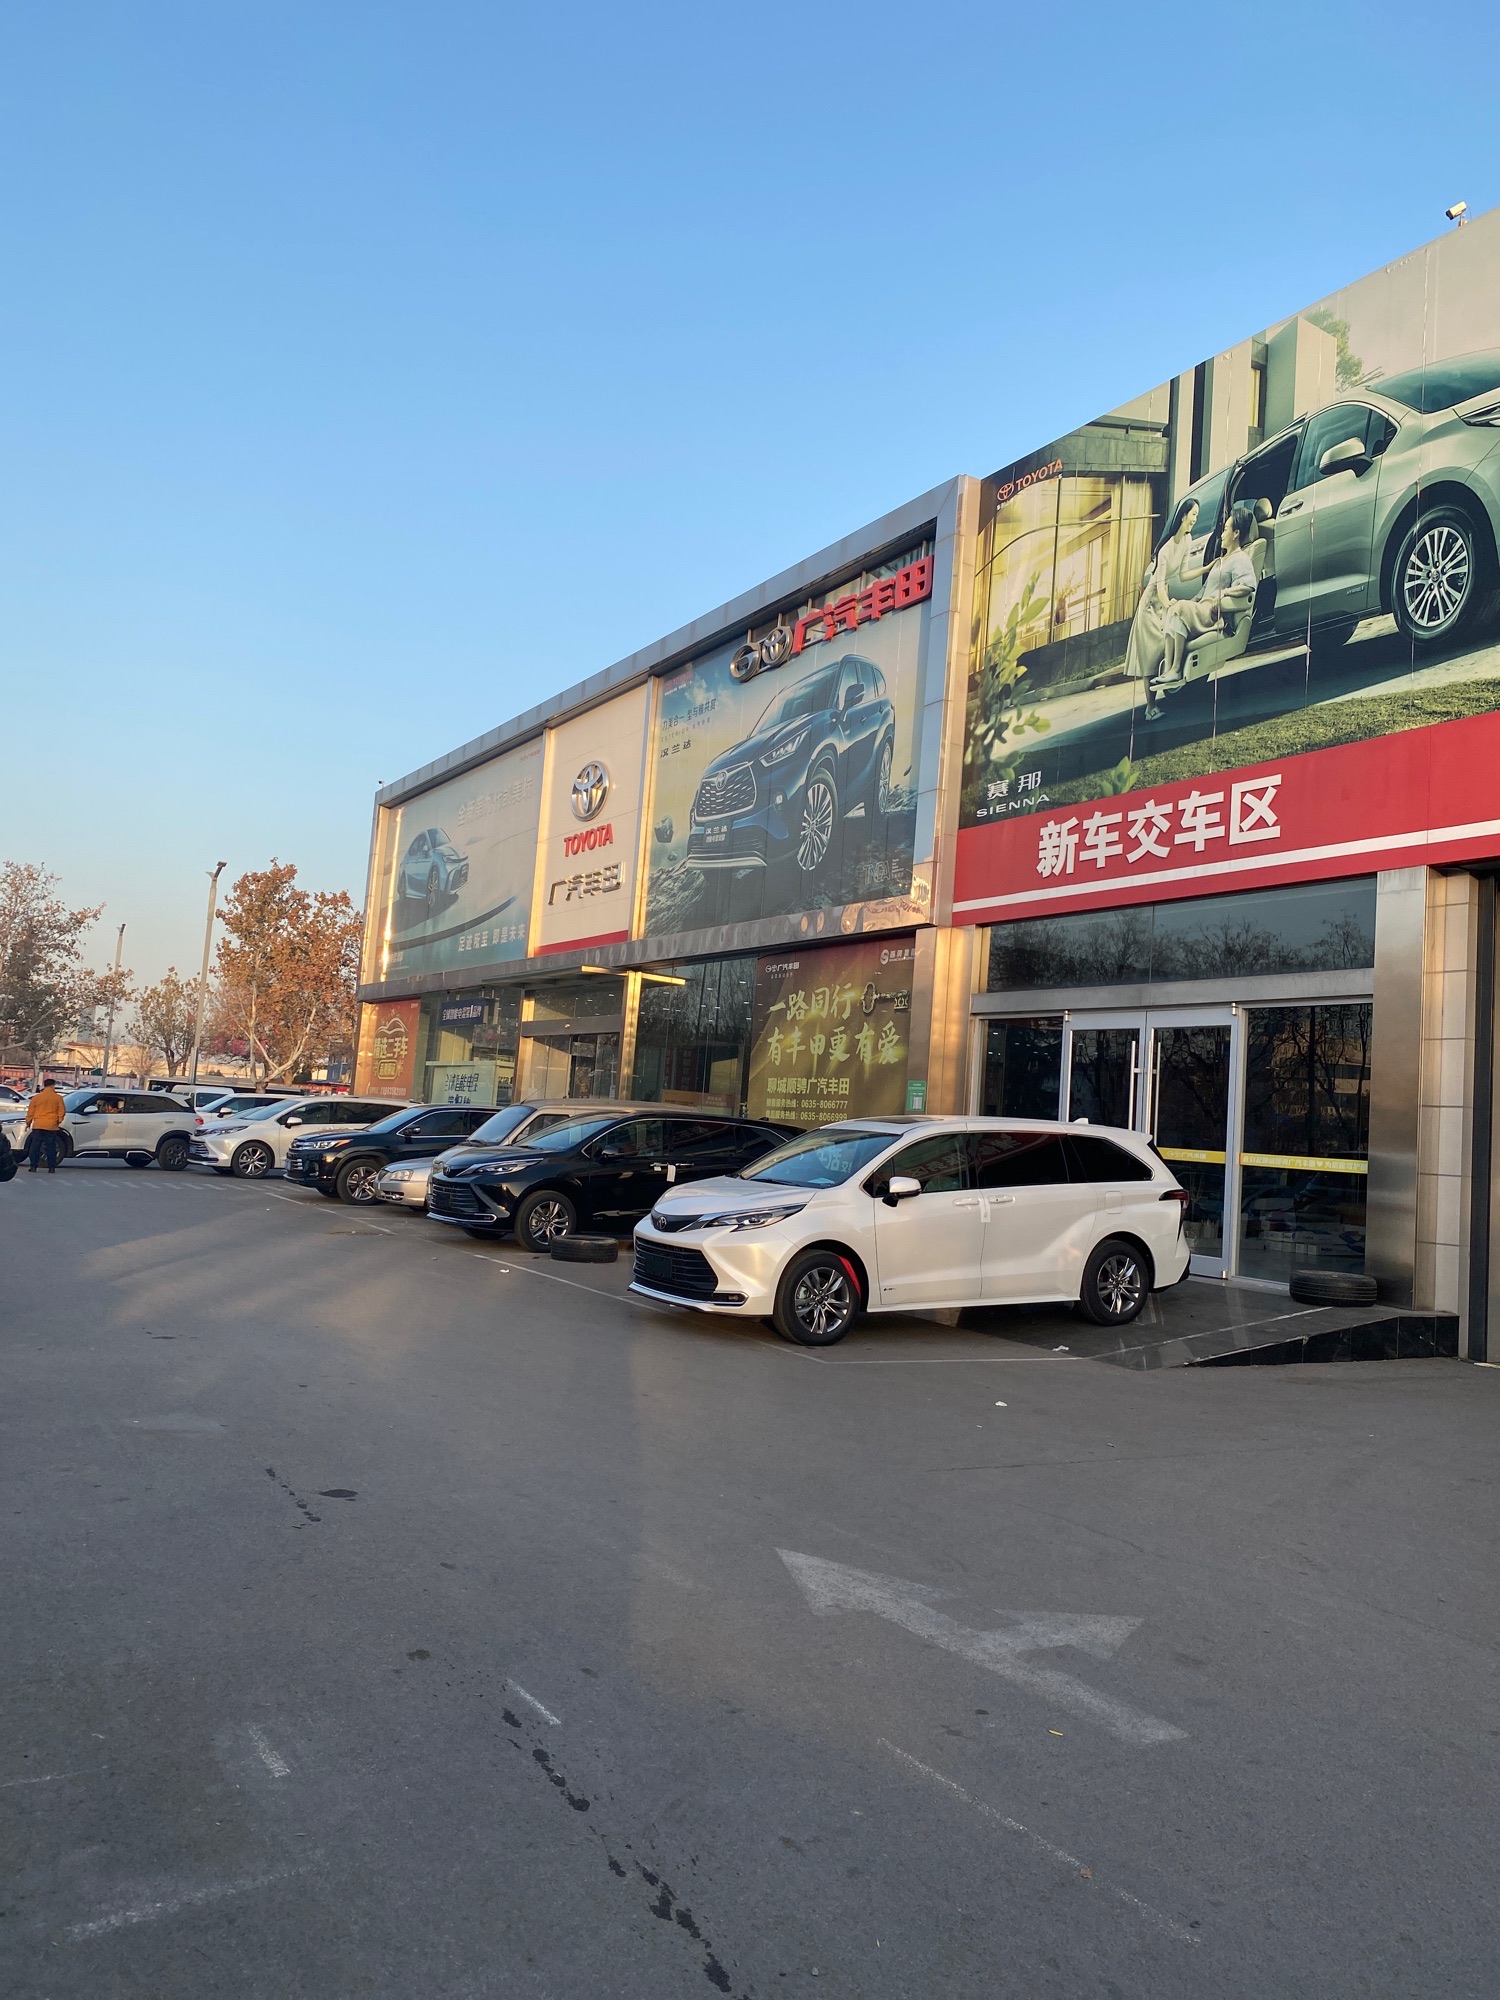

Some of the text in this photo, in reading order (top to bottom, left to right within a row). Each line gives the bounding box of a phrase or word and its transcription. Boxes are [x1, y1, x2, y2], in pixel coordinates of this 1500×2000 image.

[1016, 458, 1063, 491] TOYOTA
[790, 555, 934, 654] 广汽丰田
[987, 771, 1042, 800] 赛那
[976, 794, 1050, 817] SIENNA
[564, 823, 614, 857] TOYOTA
[1037, 774, 1283, 878] 新车交车区
[548, 861, 625, 906] 广汽丰田
[863, 861, 890, 884] TNGA
[458, 924, 526, 952] 足迹所至 即是未来
[777, 962, 800, 971] 广汽丰田
[768, 983, 853, 1021] 一路同行
[374, 1036, 409, 1059] 精选二手车
[767, 1021, 902, 1066] 有丰田更有爱
[767, 1077, 850, 1095] 聊城顺骋广汽丰田
